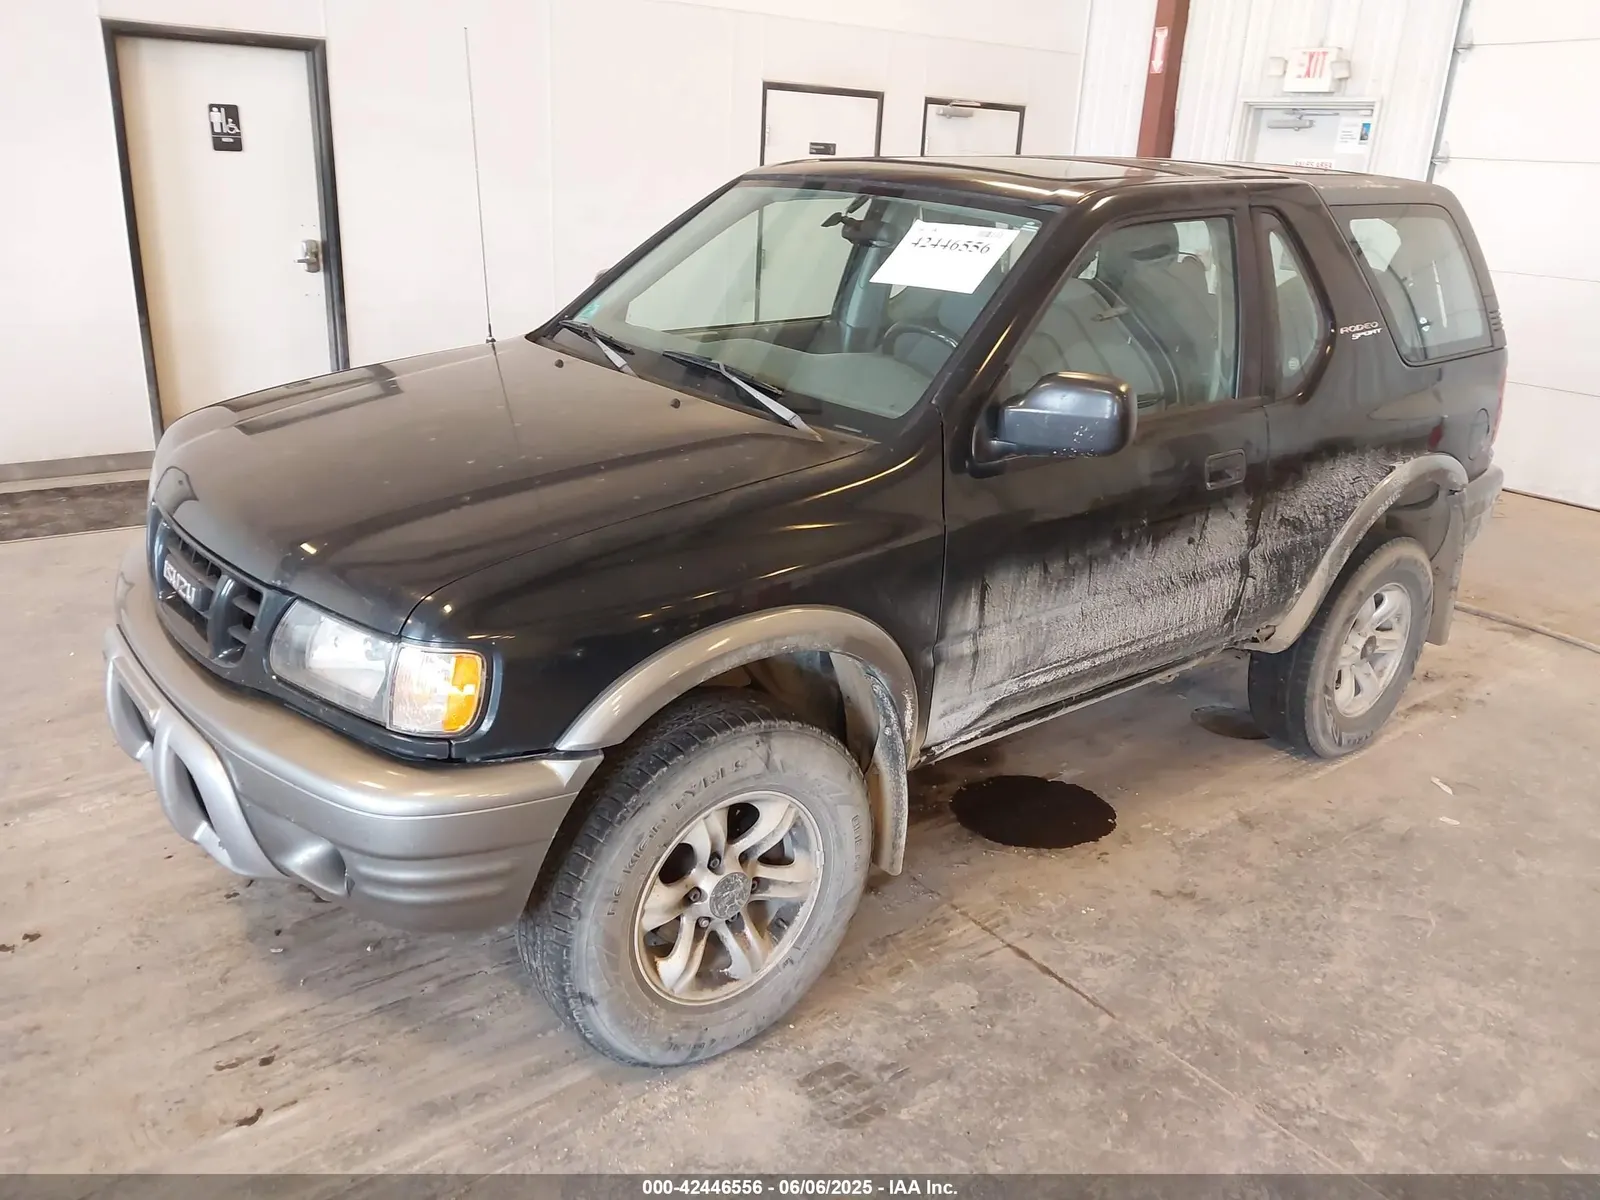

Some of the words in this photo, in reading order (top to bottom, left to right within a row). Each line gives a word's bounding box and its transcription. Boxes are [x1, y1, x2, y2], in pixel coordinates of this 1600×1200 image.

[1295, 51, 1330, 79] EXIT
[911, 237, 991, 255] 42446556
[1340, 321, 1379, 335] RODEO
[1351, 328, 1382, 340] SPORT
